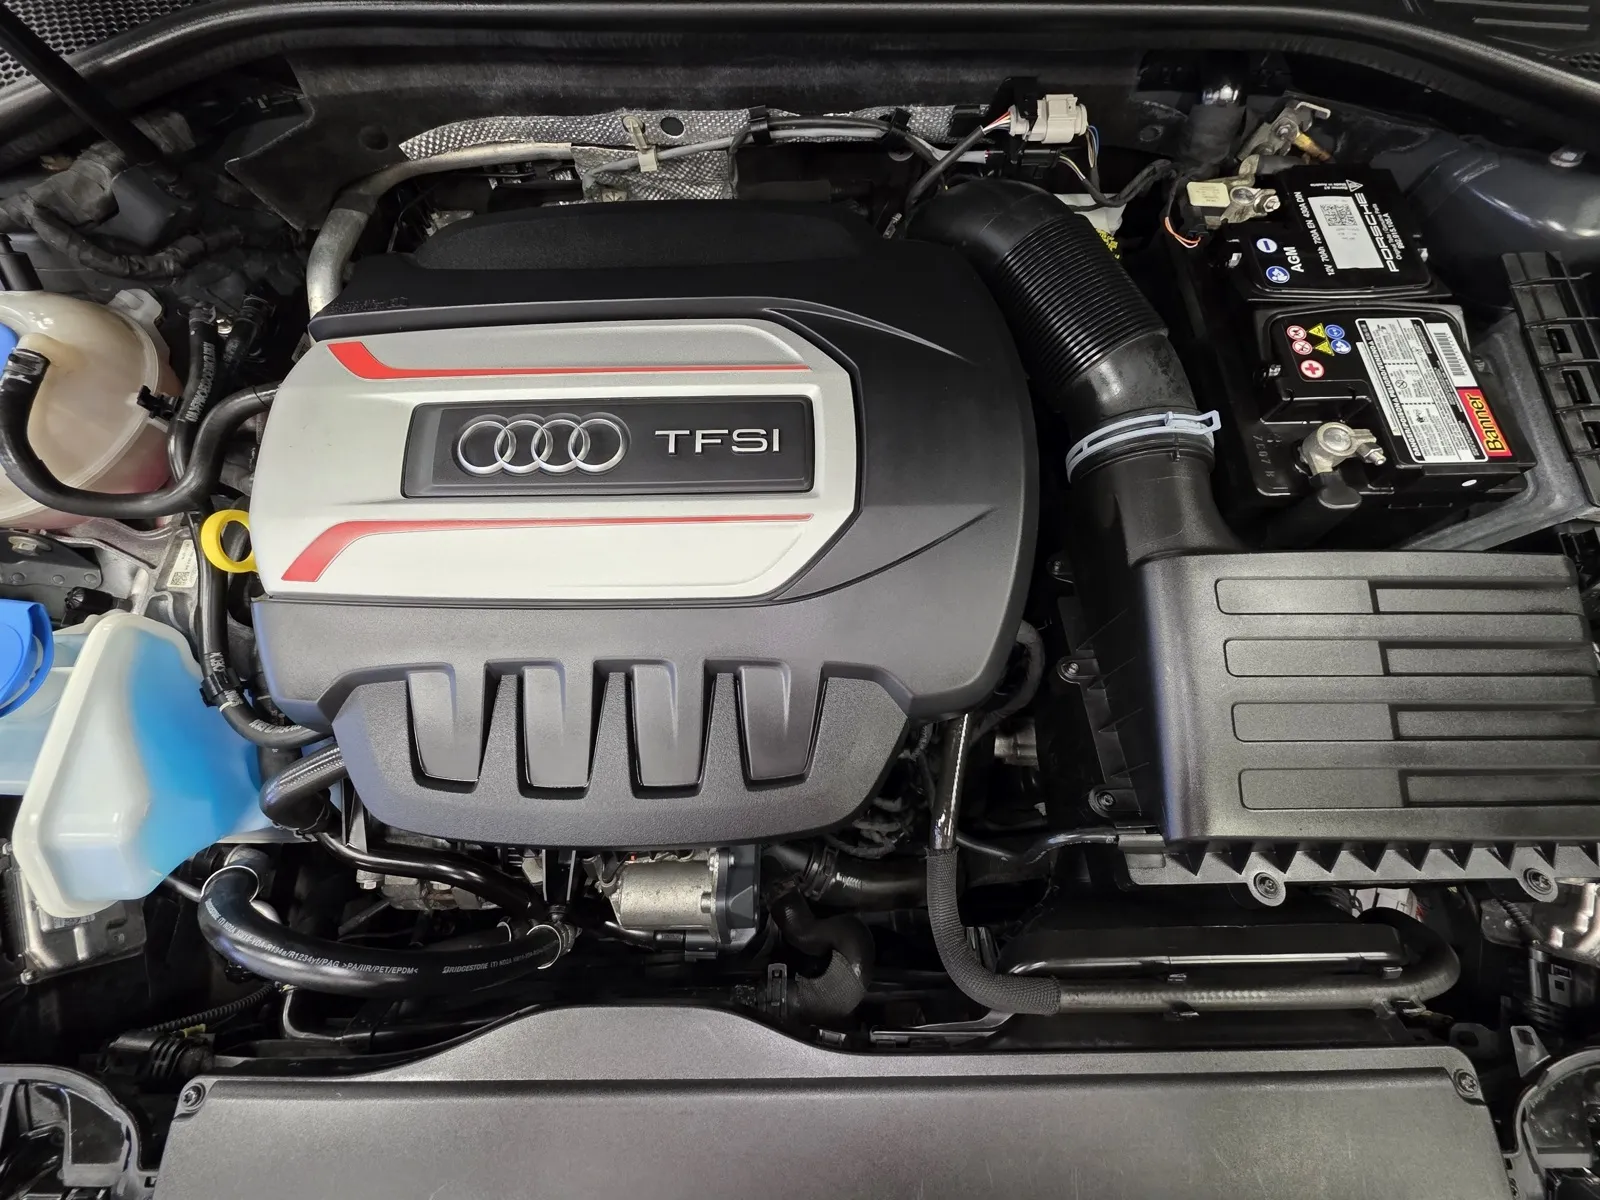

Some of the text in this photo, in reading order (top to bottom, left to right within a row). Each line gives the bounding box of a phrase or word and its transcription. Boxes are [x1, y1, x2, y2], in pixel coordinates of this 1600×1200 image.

[1294, 191, 1305, 203] DIN
[1305, 219, 1316, 229] EN
[1310, 229, 1322, 244] 720A
[1355, 193, 1399, 272] PORSCHE
[1283, 246, 1304, 272] AGM
[1317, 246, 1330, 262] 70Ah
[1370, 345, 1397, 398] PELIGRO/VENENO
[1392, 402, 1421, 457] DANGER/POISON
[1467, 394, 1505, 451] Banner
[655, 428, 780, 454] TFSI
[441, 962, 489, 974] BRIDGESTONE
